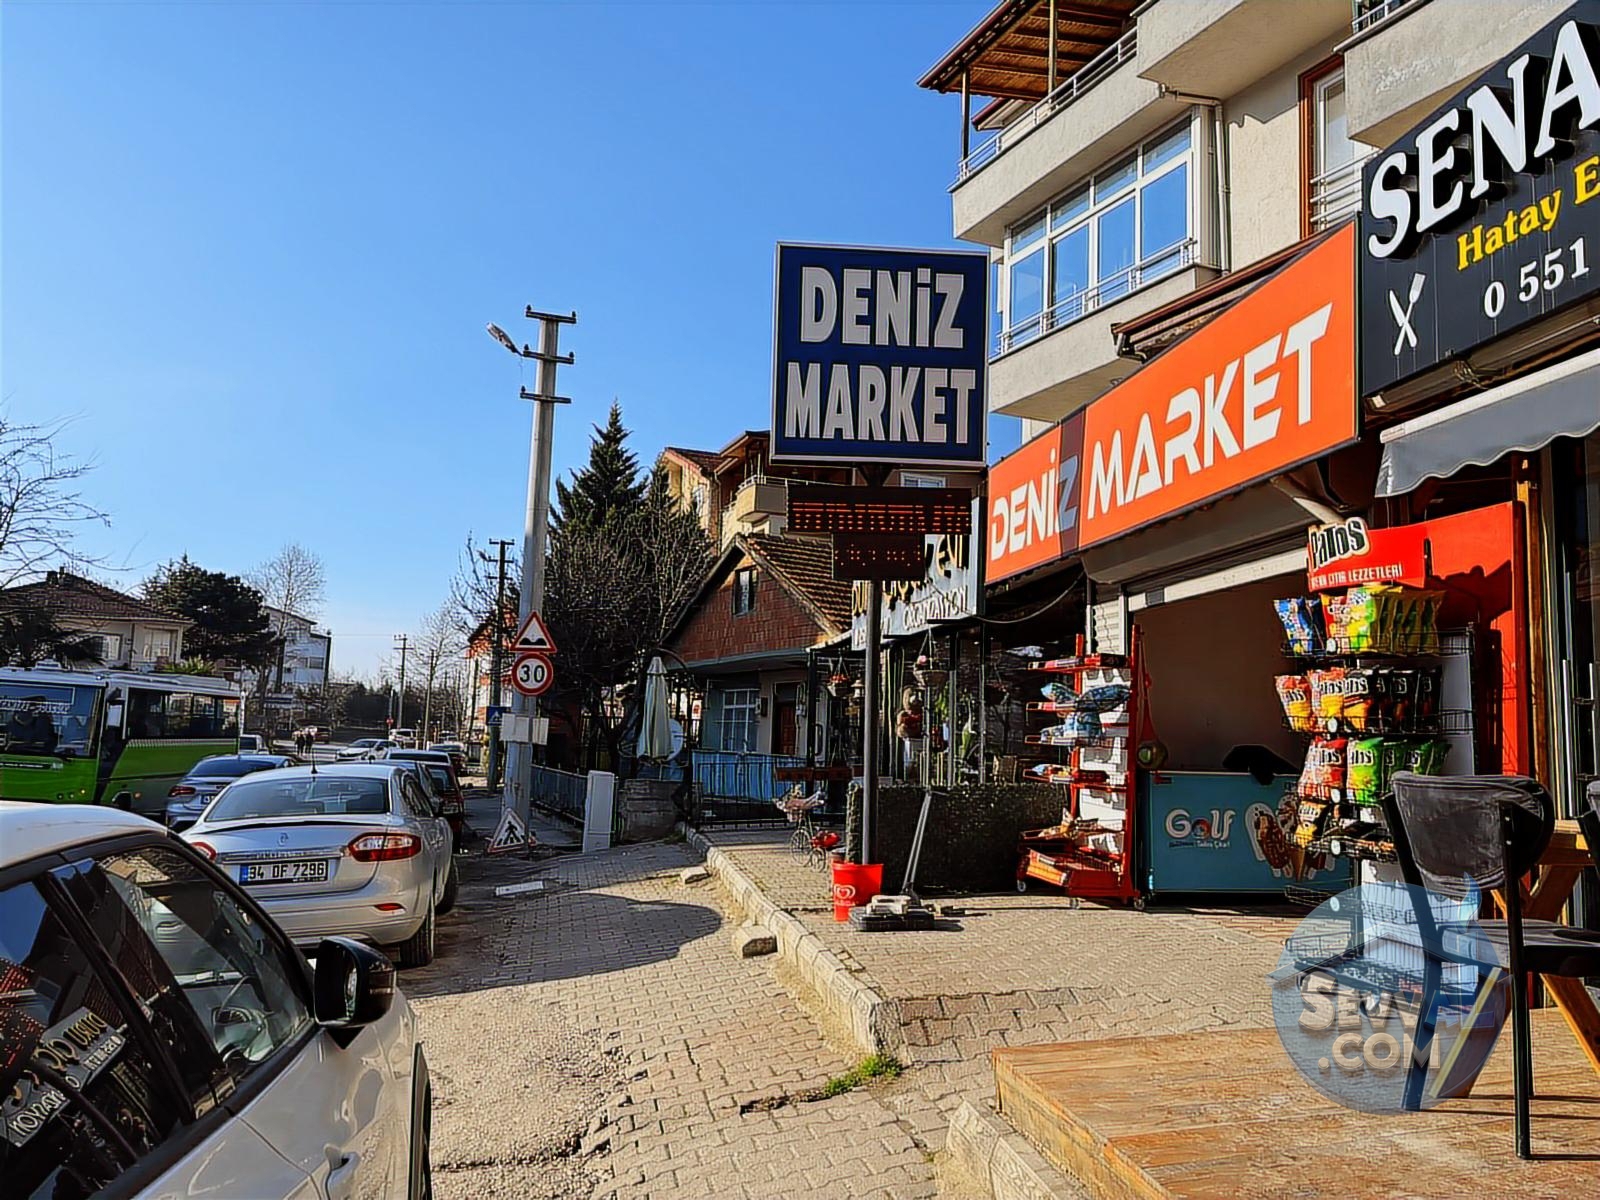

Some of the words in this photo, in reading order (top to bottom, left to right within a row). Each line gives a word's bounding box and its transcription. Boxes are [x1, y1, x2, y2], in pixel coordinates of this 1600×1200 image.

[1368, 19, 1600, 259] SENA
[1457, 189, 1562, 271] Hatay
[800, 266, 964, 348] DENİZ
[1484, 281, 1505, 318] 0
[1518, 237, 1590, 303] 551
[785, 362, 976, 444] MARKET
[990, 447, 1079, 561] DENİZ
[1087, 302, 1333, 520] MARKET
[1311, 520, 1366, 569] PATOS
[519, 664, 545, 683] 30
[1166, 809, 1236, 841] Golf
[249, 865, 264, 880] 34
[293, 862, 325, 877] 7296
